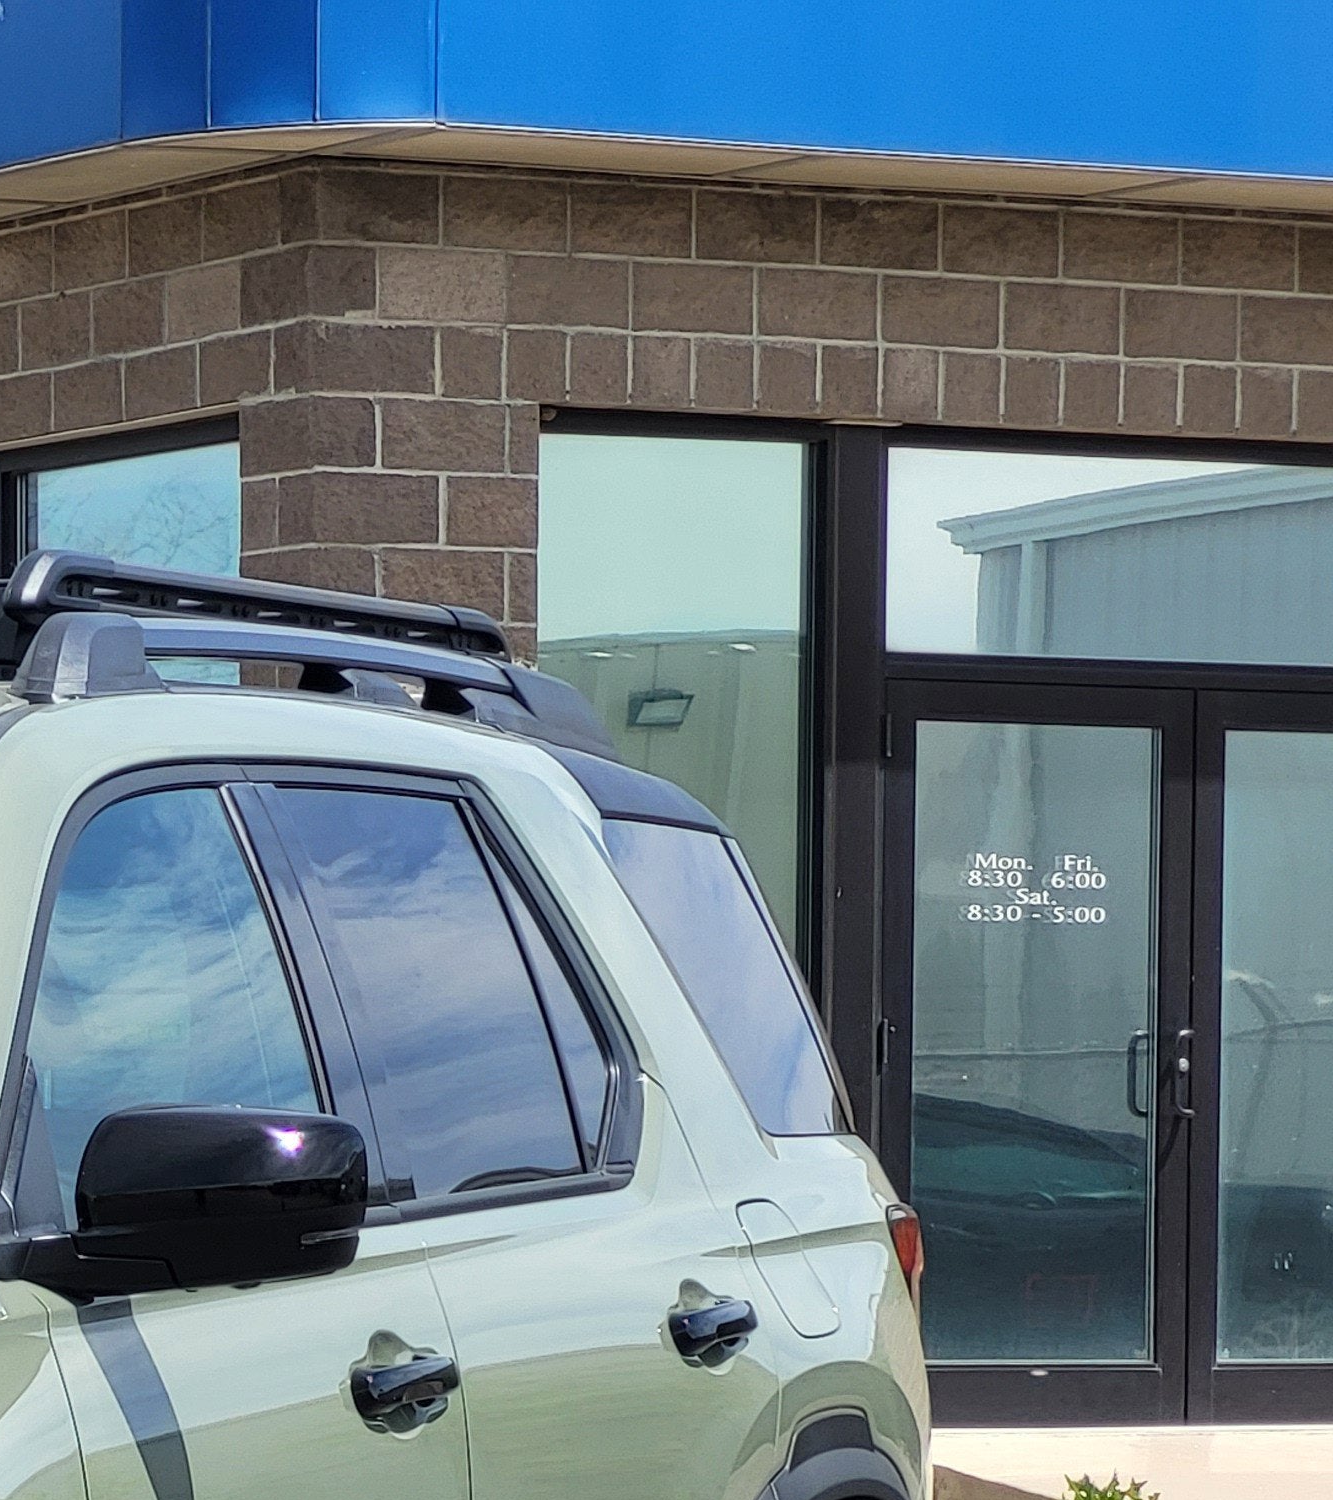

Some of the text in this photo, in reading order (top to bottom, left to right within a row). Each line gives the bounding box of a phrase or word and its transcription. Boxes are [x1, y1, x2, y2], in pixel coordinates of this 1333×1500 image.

[974, 853, 1099, 872] Mon. Fri.
[967, 870, 1107, 889] 8:30 6:00
[1014, 888, 1058, 905] Sat.
[966, 904, 1023, 922] 8:30
[1052, 906, 1106, 924] 5:00
